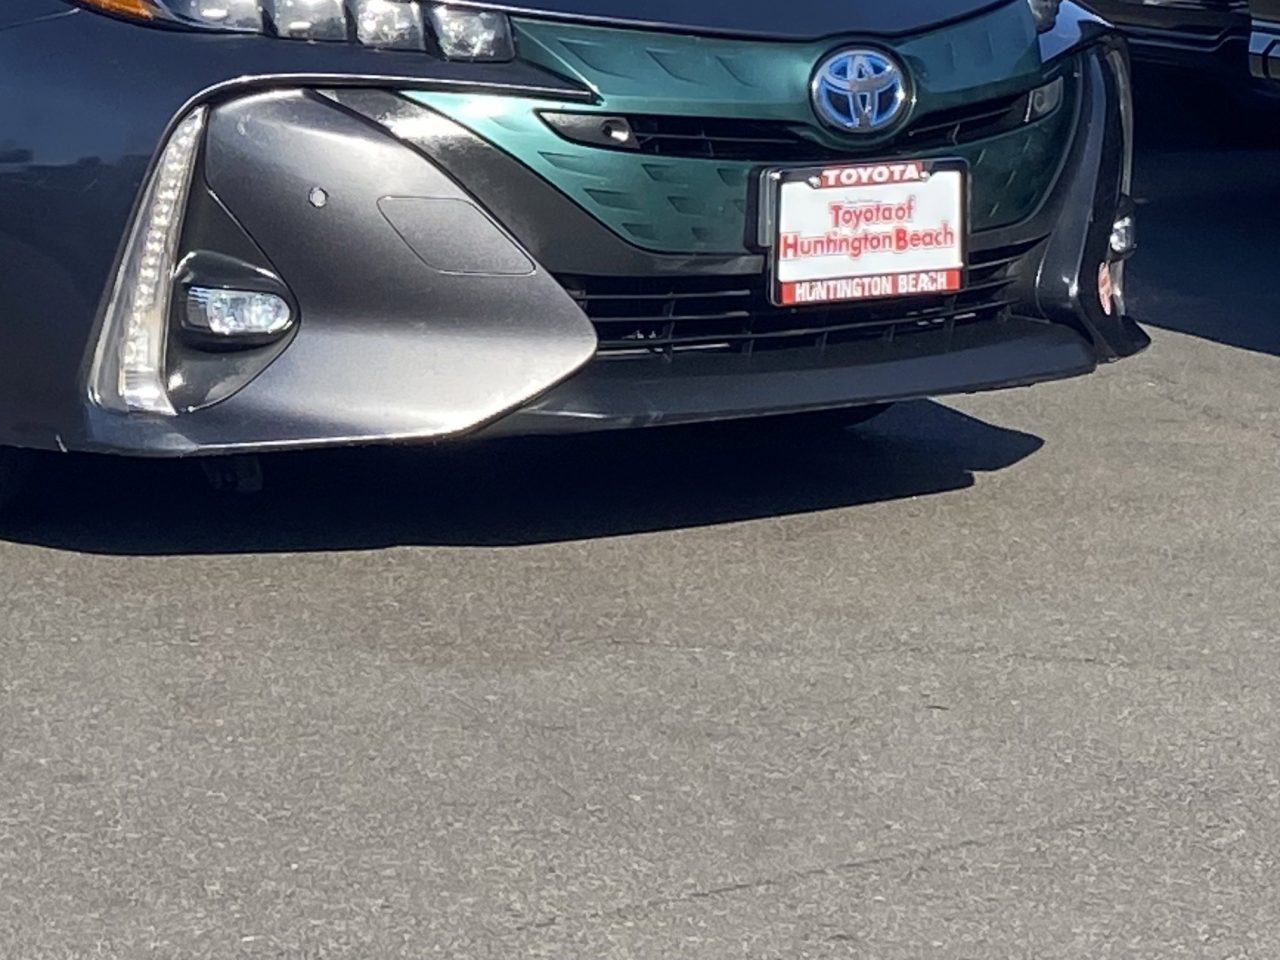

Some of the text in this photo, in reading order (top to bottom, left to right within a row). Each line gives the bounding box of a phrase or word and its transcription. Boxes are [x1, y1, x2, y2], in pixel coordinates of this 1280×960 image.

[822, 164, 920, 187] TOYOTA
[830, 196, 915, 229] Toyota of
[782, 222, 955, 258] Huntington Beach
[795, 271, 947, 302] HUNTINGTON BEACH
